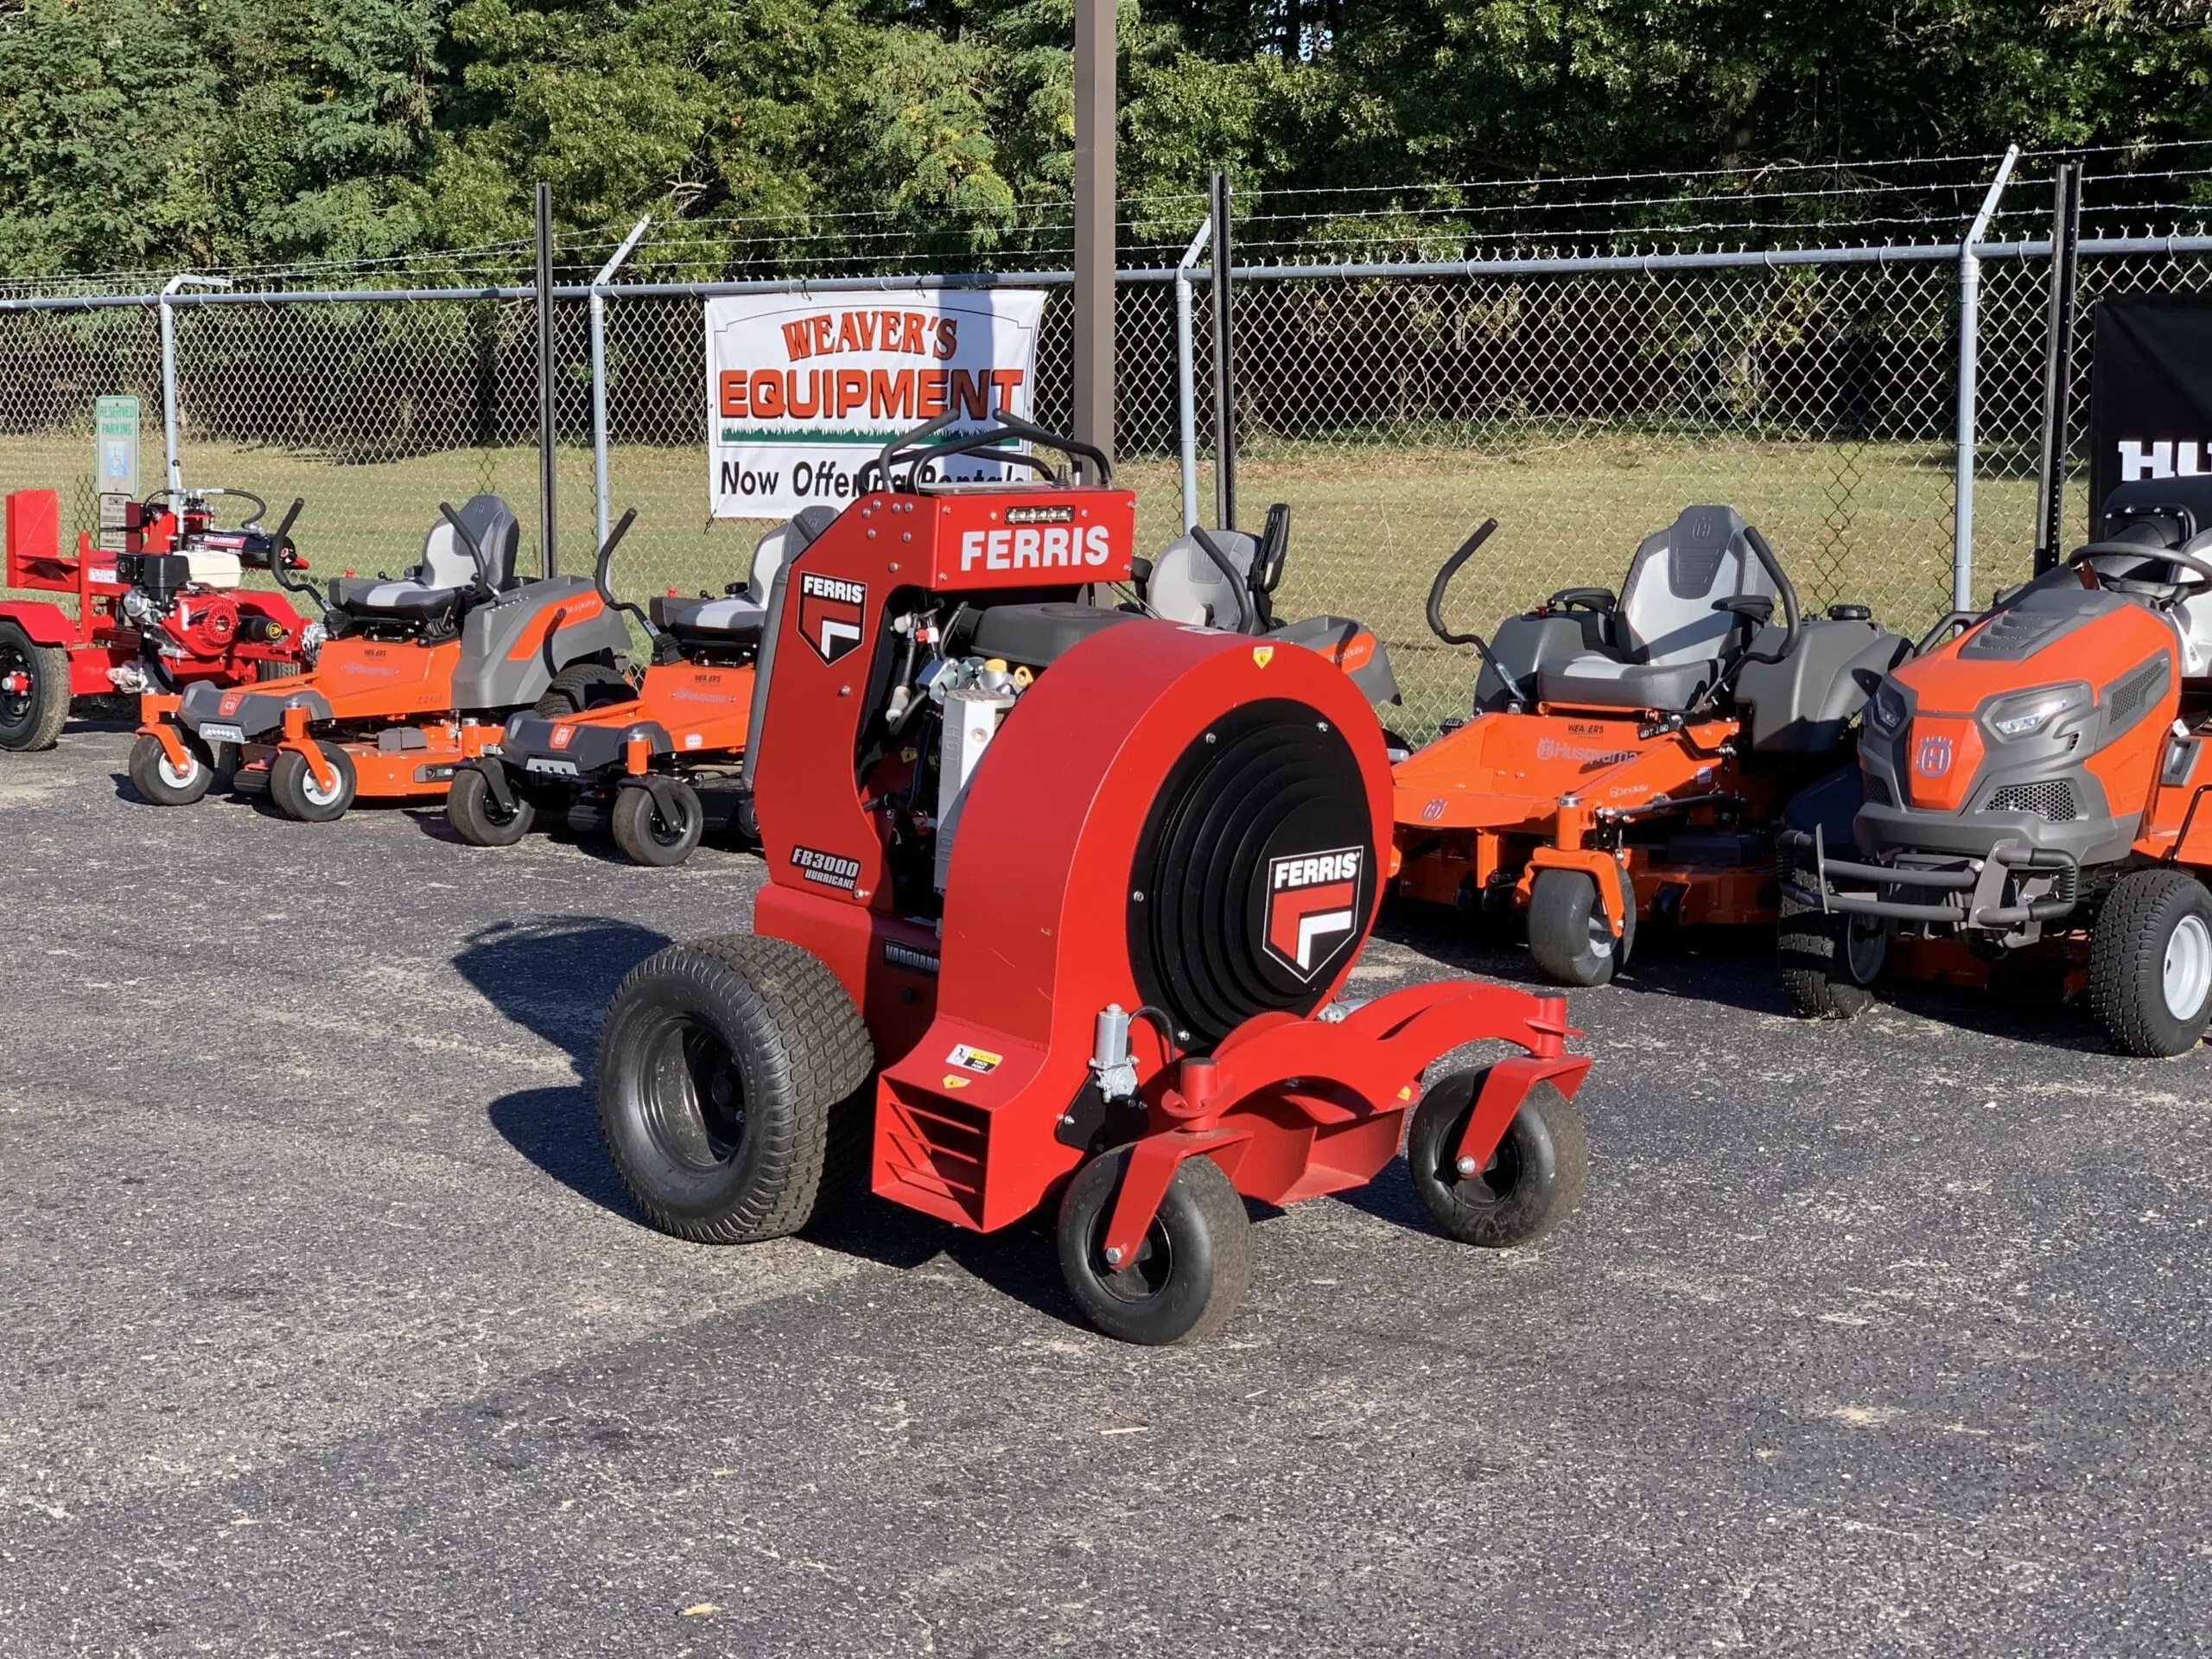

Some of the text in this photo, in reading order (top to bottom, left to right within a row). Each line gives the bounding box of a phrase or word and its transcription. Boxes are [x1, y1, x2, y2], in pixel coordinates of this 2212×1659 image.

[781, 311, 958, 361] WEAVER'S
[720, 369, 1024, 420] EQUIPMENT
[99, 405, 135, 418] RESERVED
[101, 423, 132, 435] PARKING
[721, 461, 779, 495] Now
[792, 461, 907, 499] Offerng
[961, 525, 1109, 571] FERRIS
[804, 575, 862, 603] FERRIS
[1555, 741, 1638, 765] Husqvarna
[791, 848, 860, 878] FB3000
[1274, 852, 1357, 889] FERRIS
[804, 868, 855, 890] HURRICANE
[886, 944, 940, 971] VANGUARD
